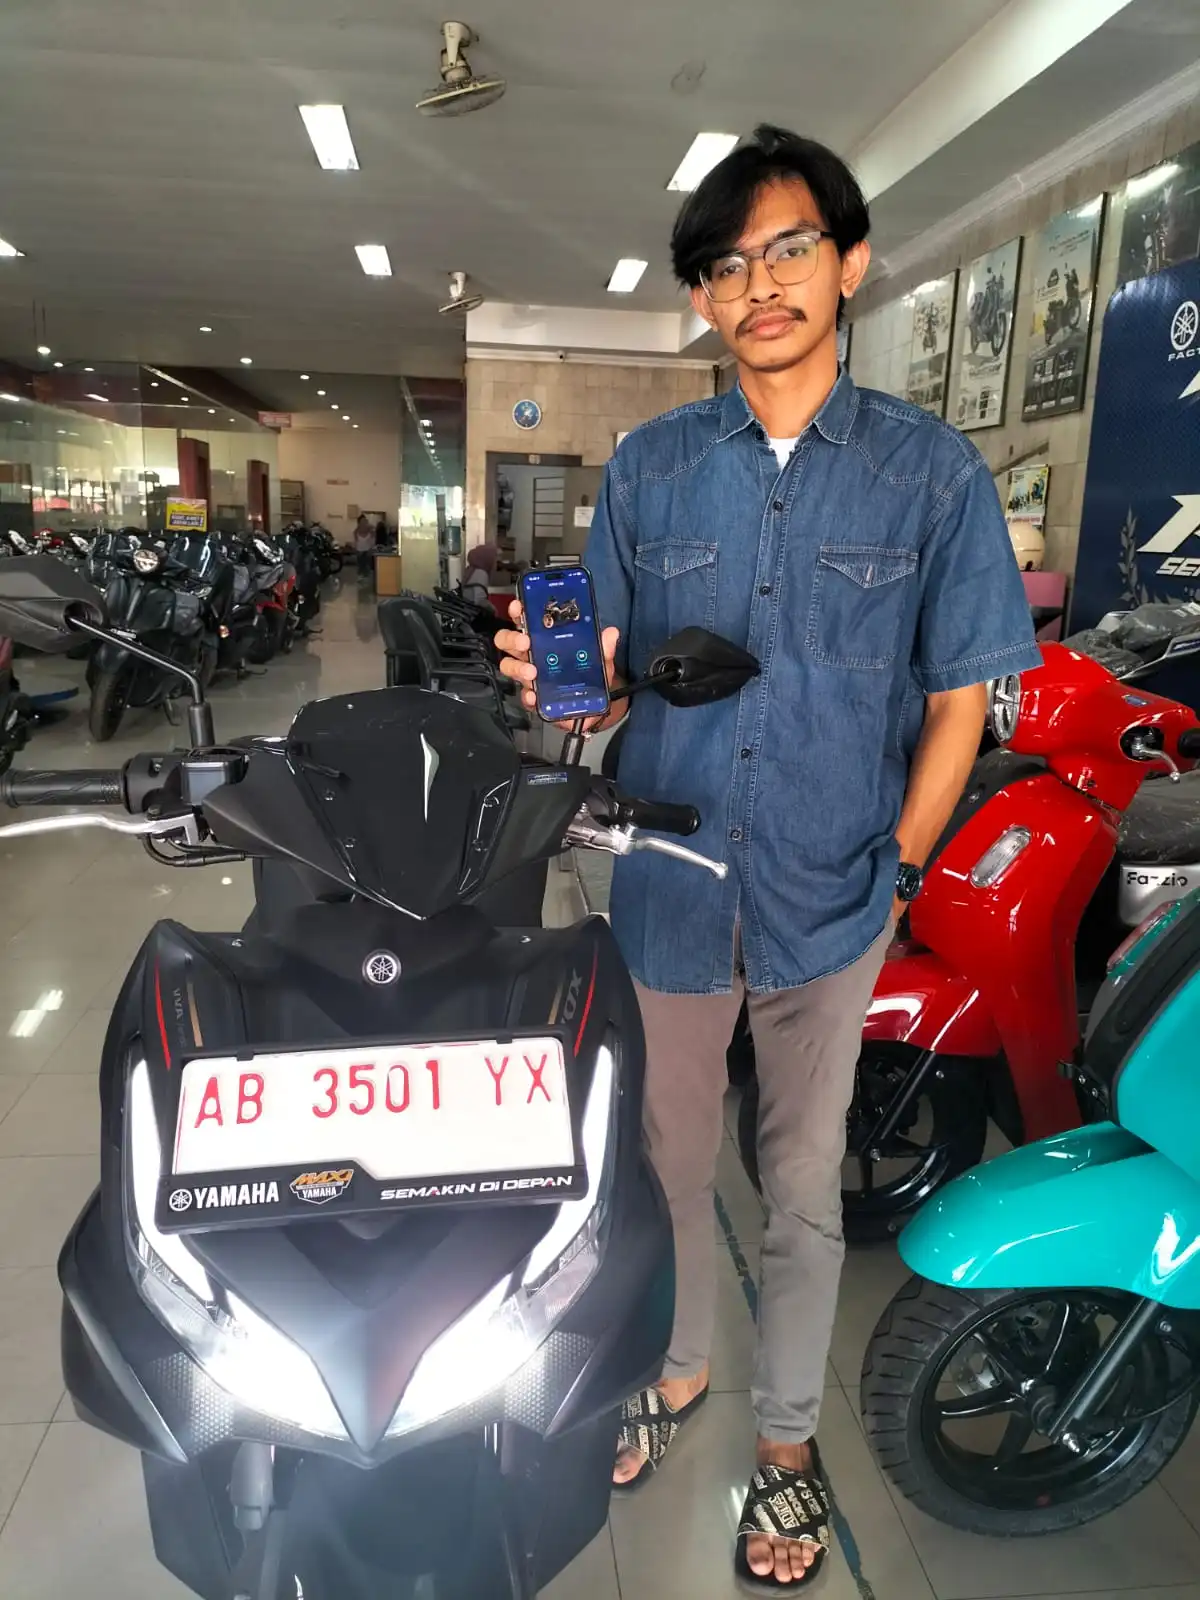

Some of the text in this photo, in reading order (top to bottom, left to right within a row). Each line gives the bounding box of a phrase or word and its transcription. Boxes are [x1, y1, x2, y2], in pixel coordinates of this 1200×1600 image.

[194, 1054, 551, 1128] AB 3501 YX
[194, 1181, 280, 1209] YAMAHA
[302, 1186, 337, 1199] YAMAHA
[380, 1175, 572, 1200] SEMAKIN DI DEPAN
